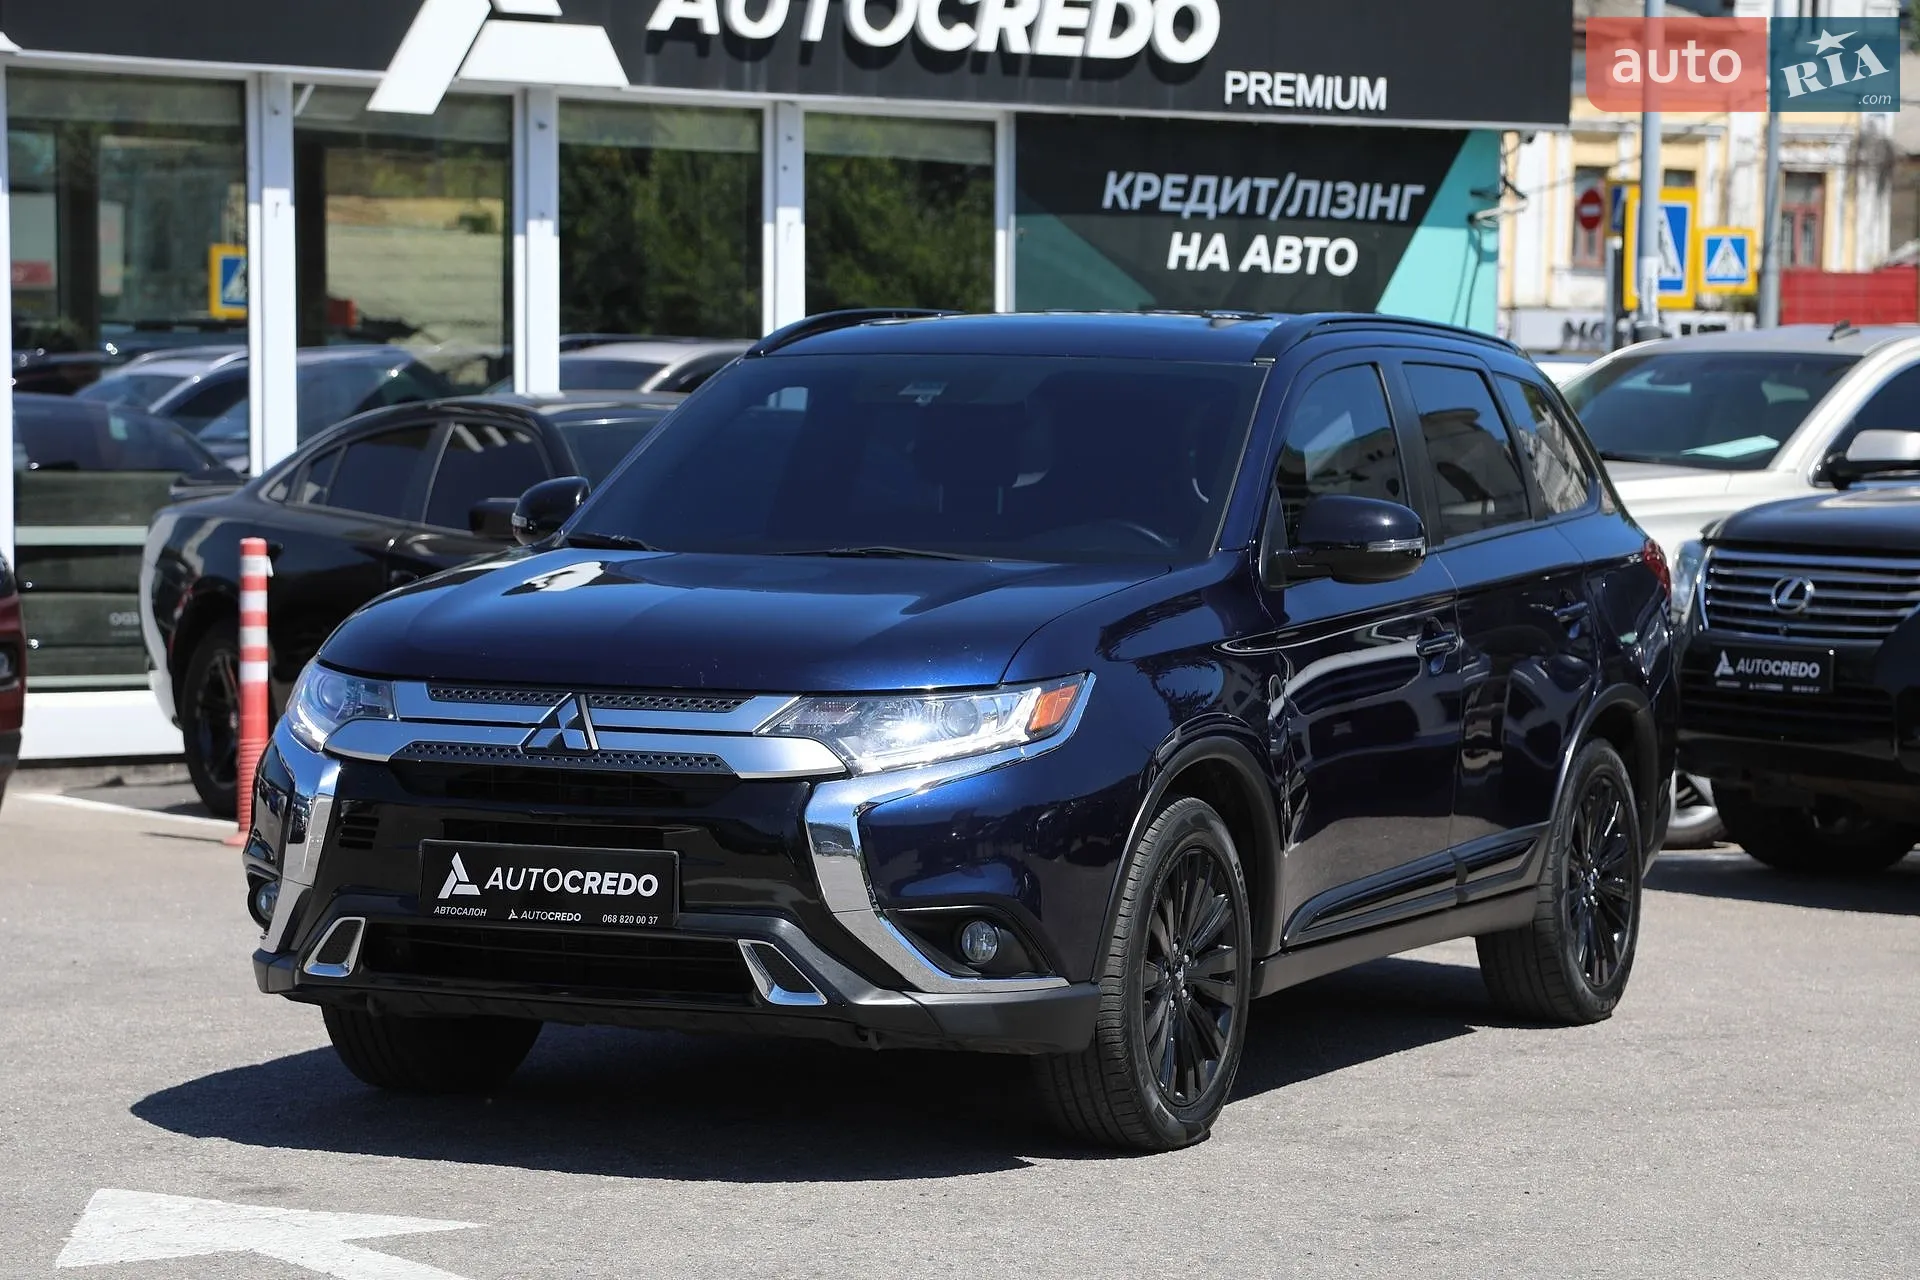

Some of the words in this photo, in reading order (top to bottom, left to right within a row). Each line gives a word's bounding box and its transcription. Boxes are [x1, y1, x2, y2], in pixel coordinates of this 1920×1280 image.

[1224, 70, 1388, 111] PREMIUM
[1102, 171, 1426, 221] КРЕДИТ/ЛІЗІНГ
[1166, 231, 1230, 272] НА
[1238, 234, 1359, 277] АВТО
[1736, 657, 1820, 679] AUTOCREDO
[484, 866, 659, 897] AUTOCREDO
[433, 905, 488, 917] АВТОСАЛОН
[520, 910, 582, 922] AUTOCREDO
[602, 914, 618, 924] 068
[619, 915, 635, 925] 820
[636, 915, 646, 925] 00
[648, 915, 658, 925] 37
